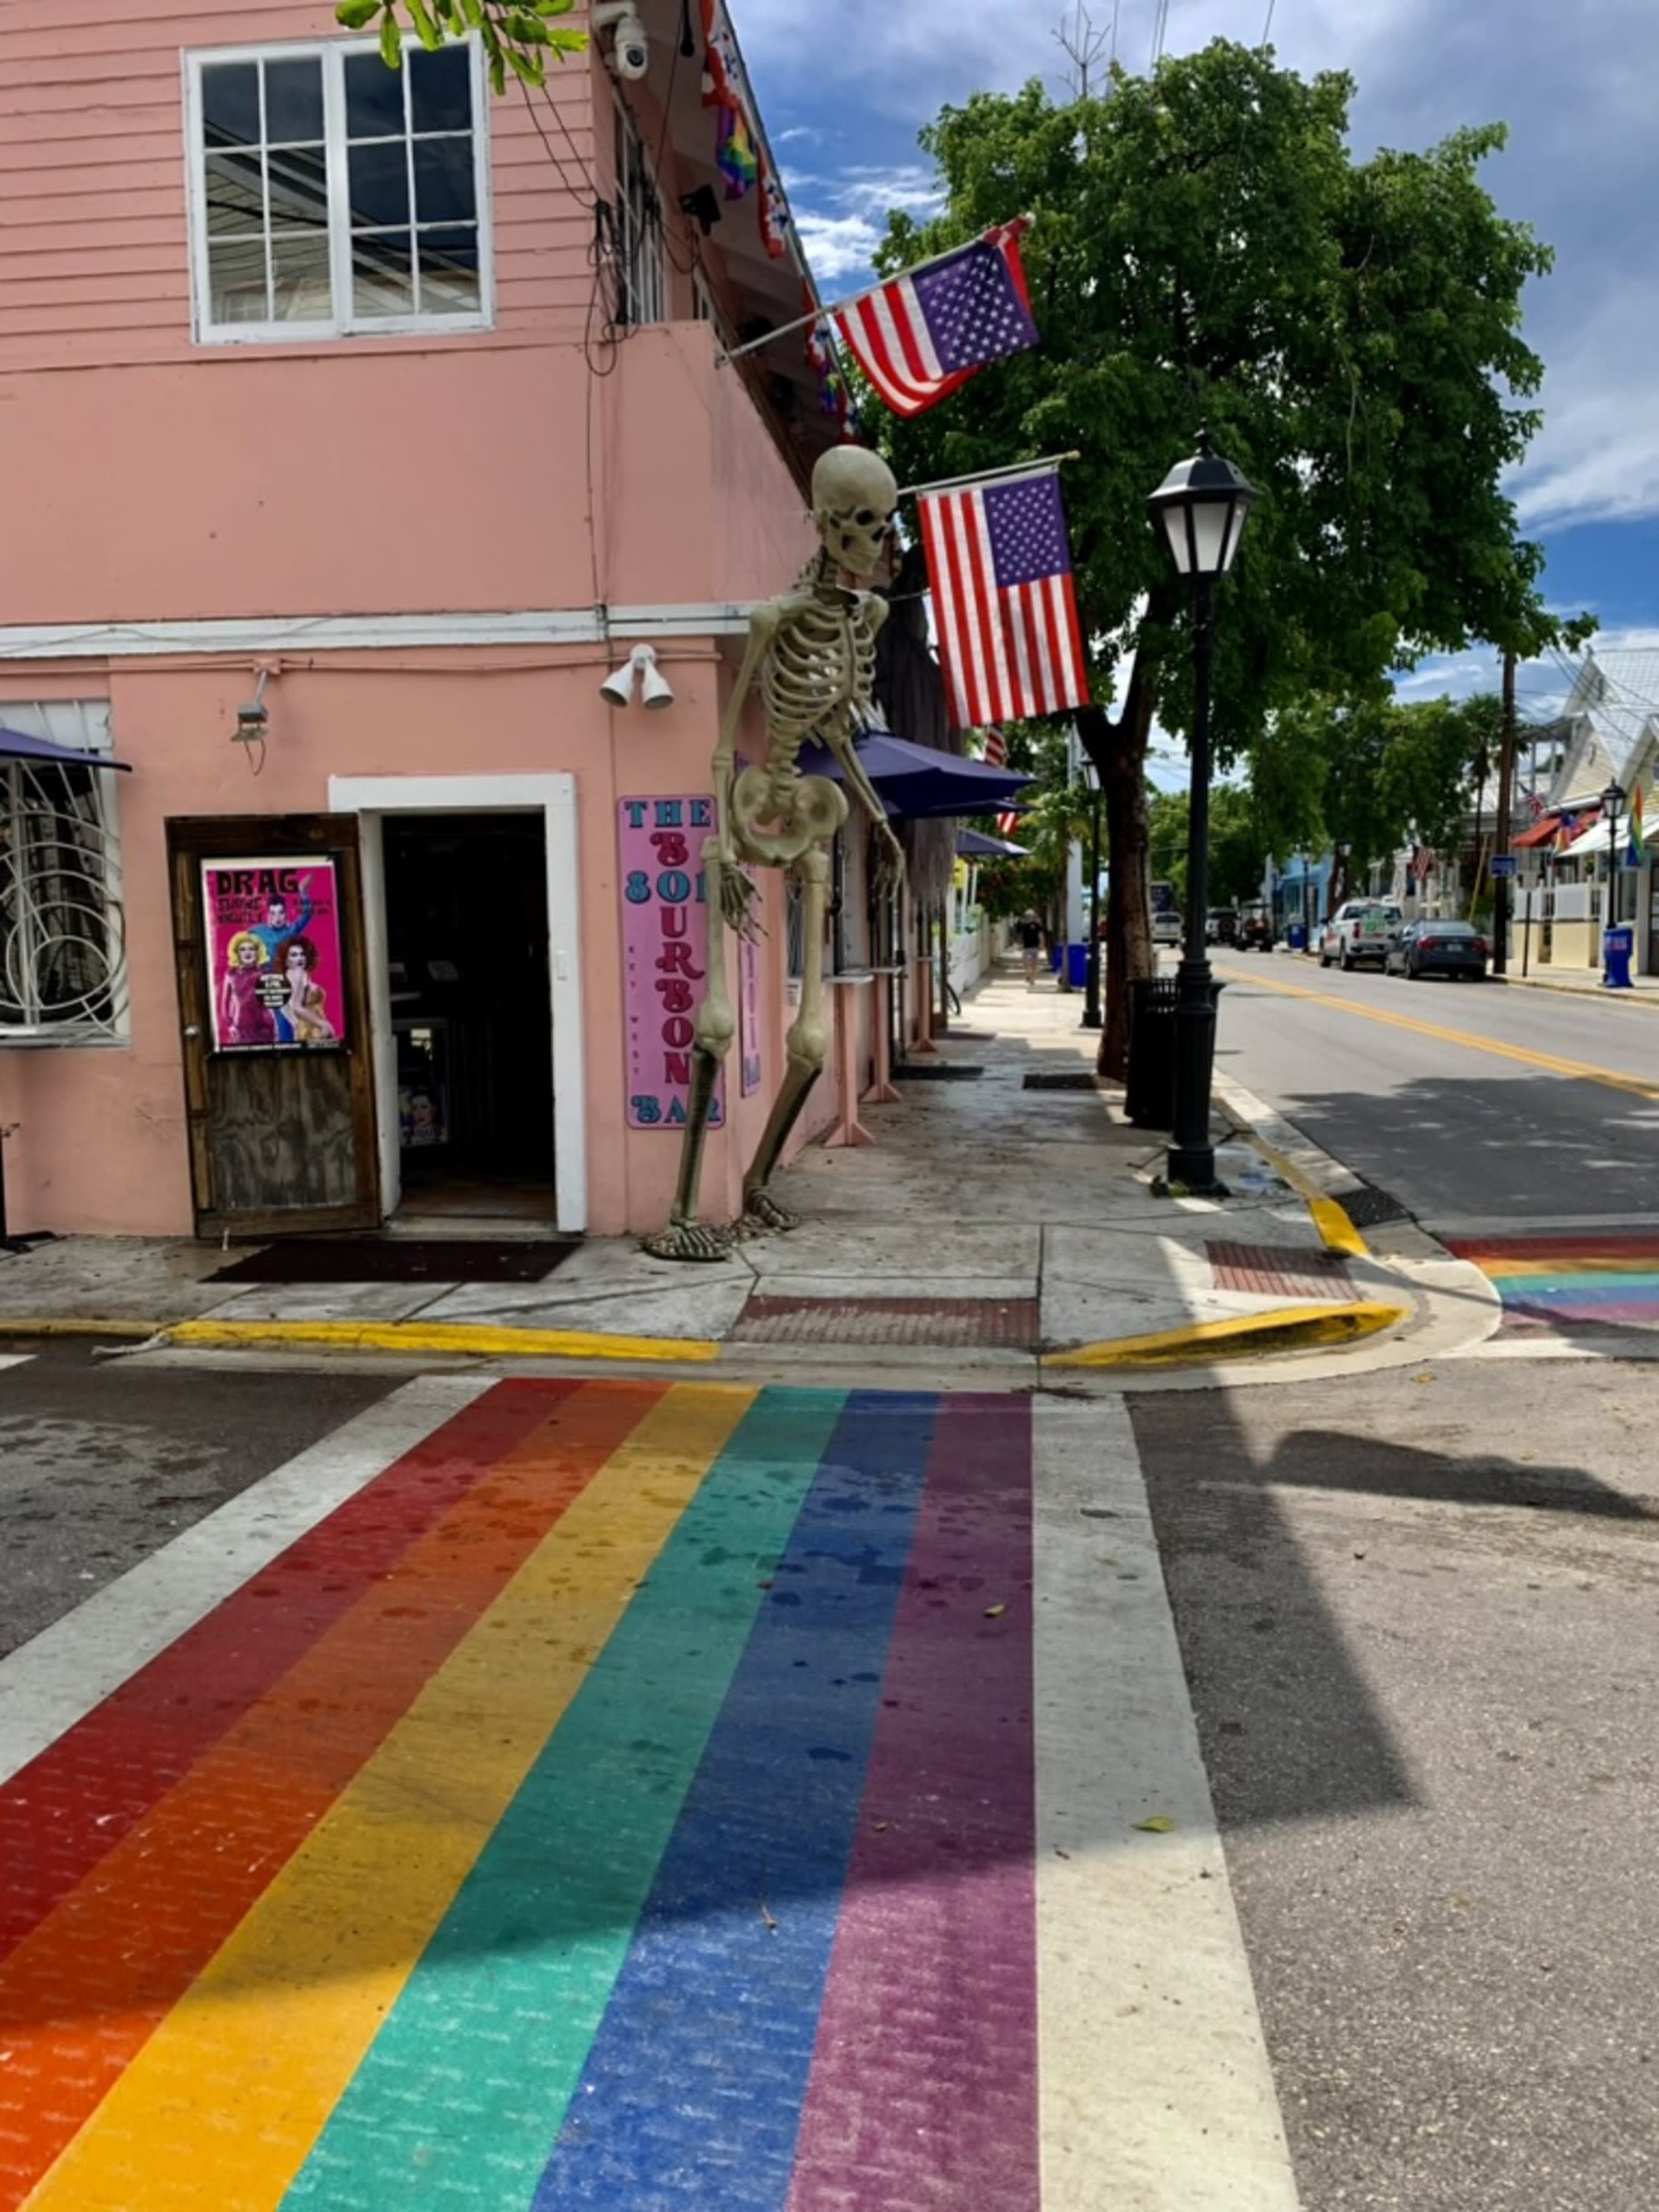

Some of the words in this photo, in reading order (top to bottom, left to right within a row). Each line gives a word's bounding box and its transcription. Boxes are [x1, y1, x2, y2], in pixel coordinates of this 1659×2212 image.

[624, 800, 711, 828] THE
[216, 868, 300, 895] DRAG
[625, 870, 709, 905] 801
[649, 832, 707, 1085] BOURBON
